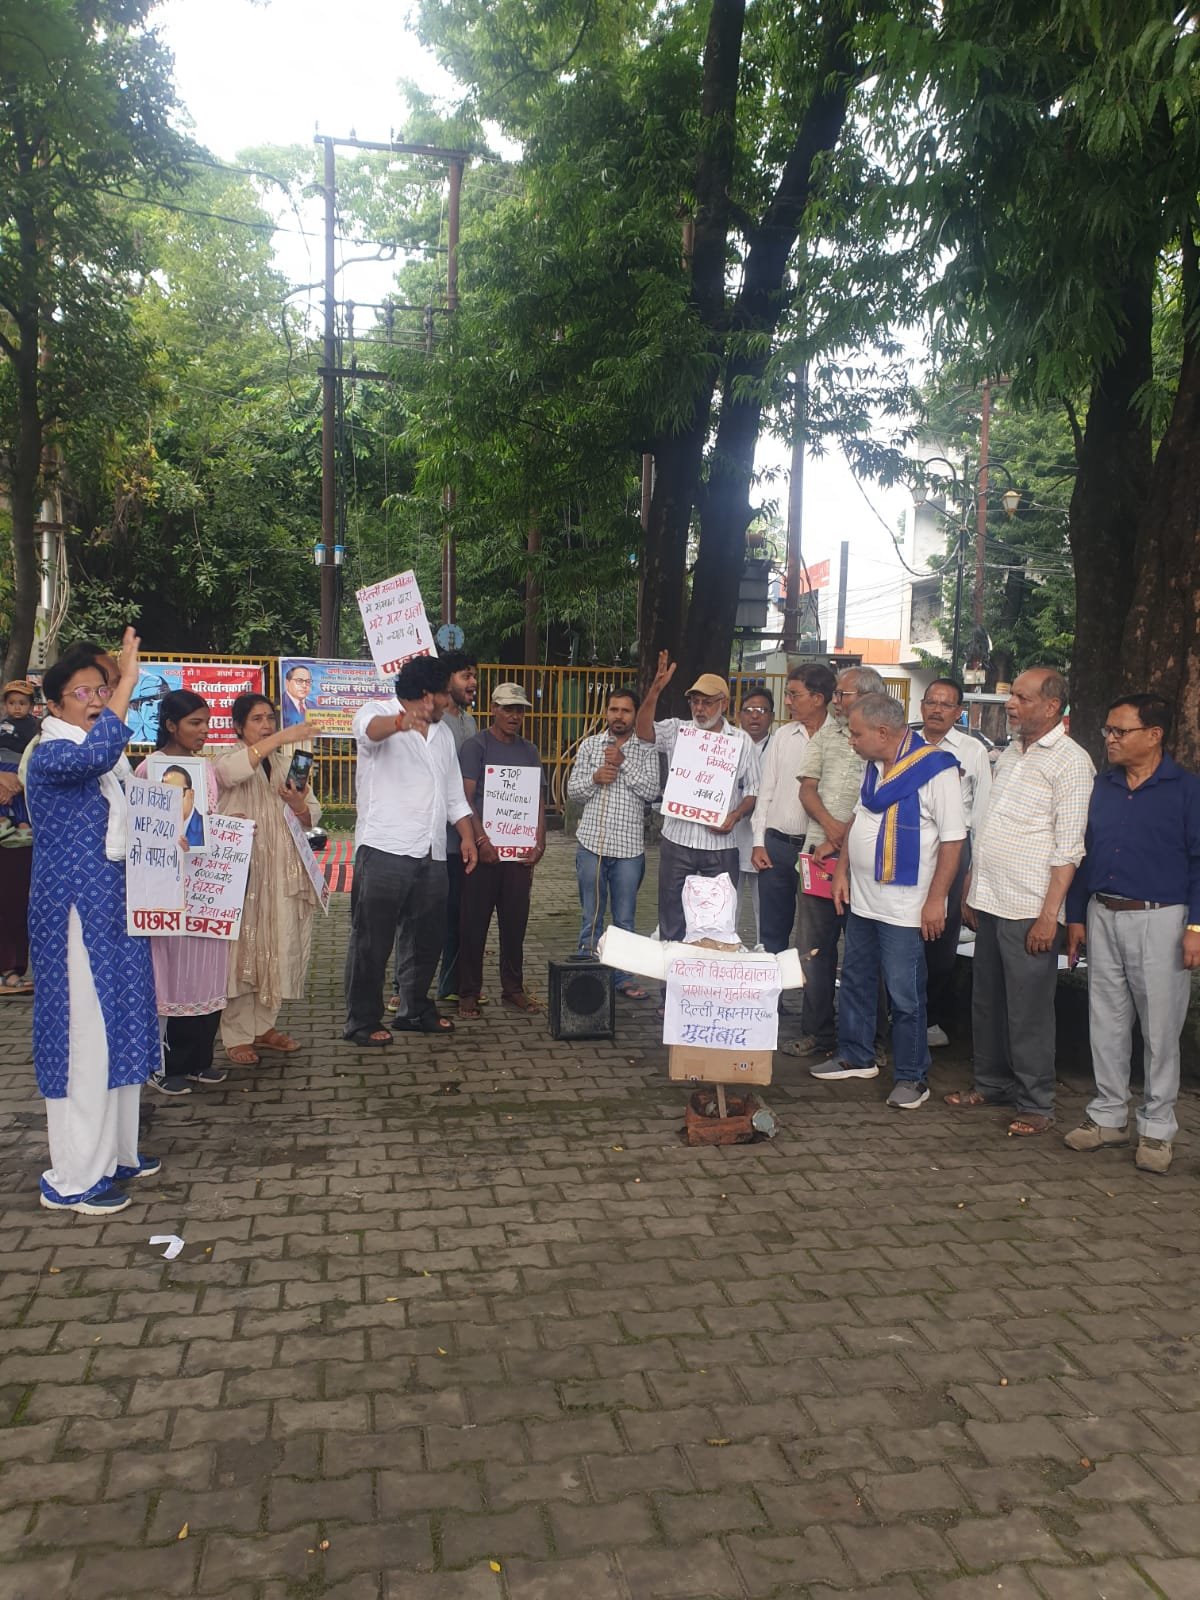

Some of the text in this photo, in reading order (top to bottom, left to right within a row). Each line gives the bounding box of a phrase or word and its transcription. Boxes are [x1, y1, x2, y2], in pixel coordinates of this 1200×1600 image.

[191, 680, 253, 693] परिवर्तनकामी
[321, 683, 351, 693] संयुक्त
[352, 682, 376, 693] संघर्ष
[500, 768, 522, 780] STOP
[675, 767, 691, 779] DU
[502, 780, 516, 790] The
[667, 801, 721, 824] पछास
[135, 816, 175, 840] NEP-2020
[130, 838, 142, 866] को
[132, 910, 182, 931] पछास
[674, 960, 779, 982] दिल्ली विश्वविद्यालय
[680, 982, 763, 1004] प्रशासन मुर्दाबाद
[679, 999, 714, 1017] दिल्ली
[680, 1018, 753, 1046] मुर्दाबाद
